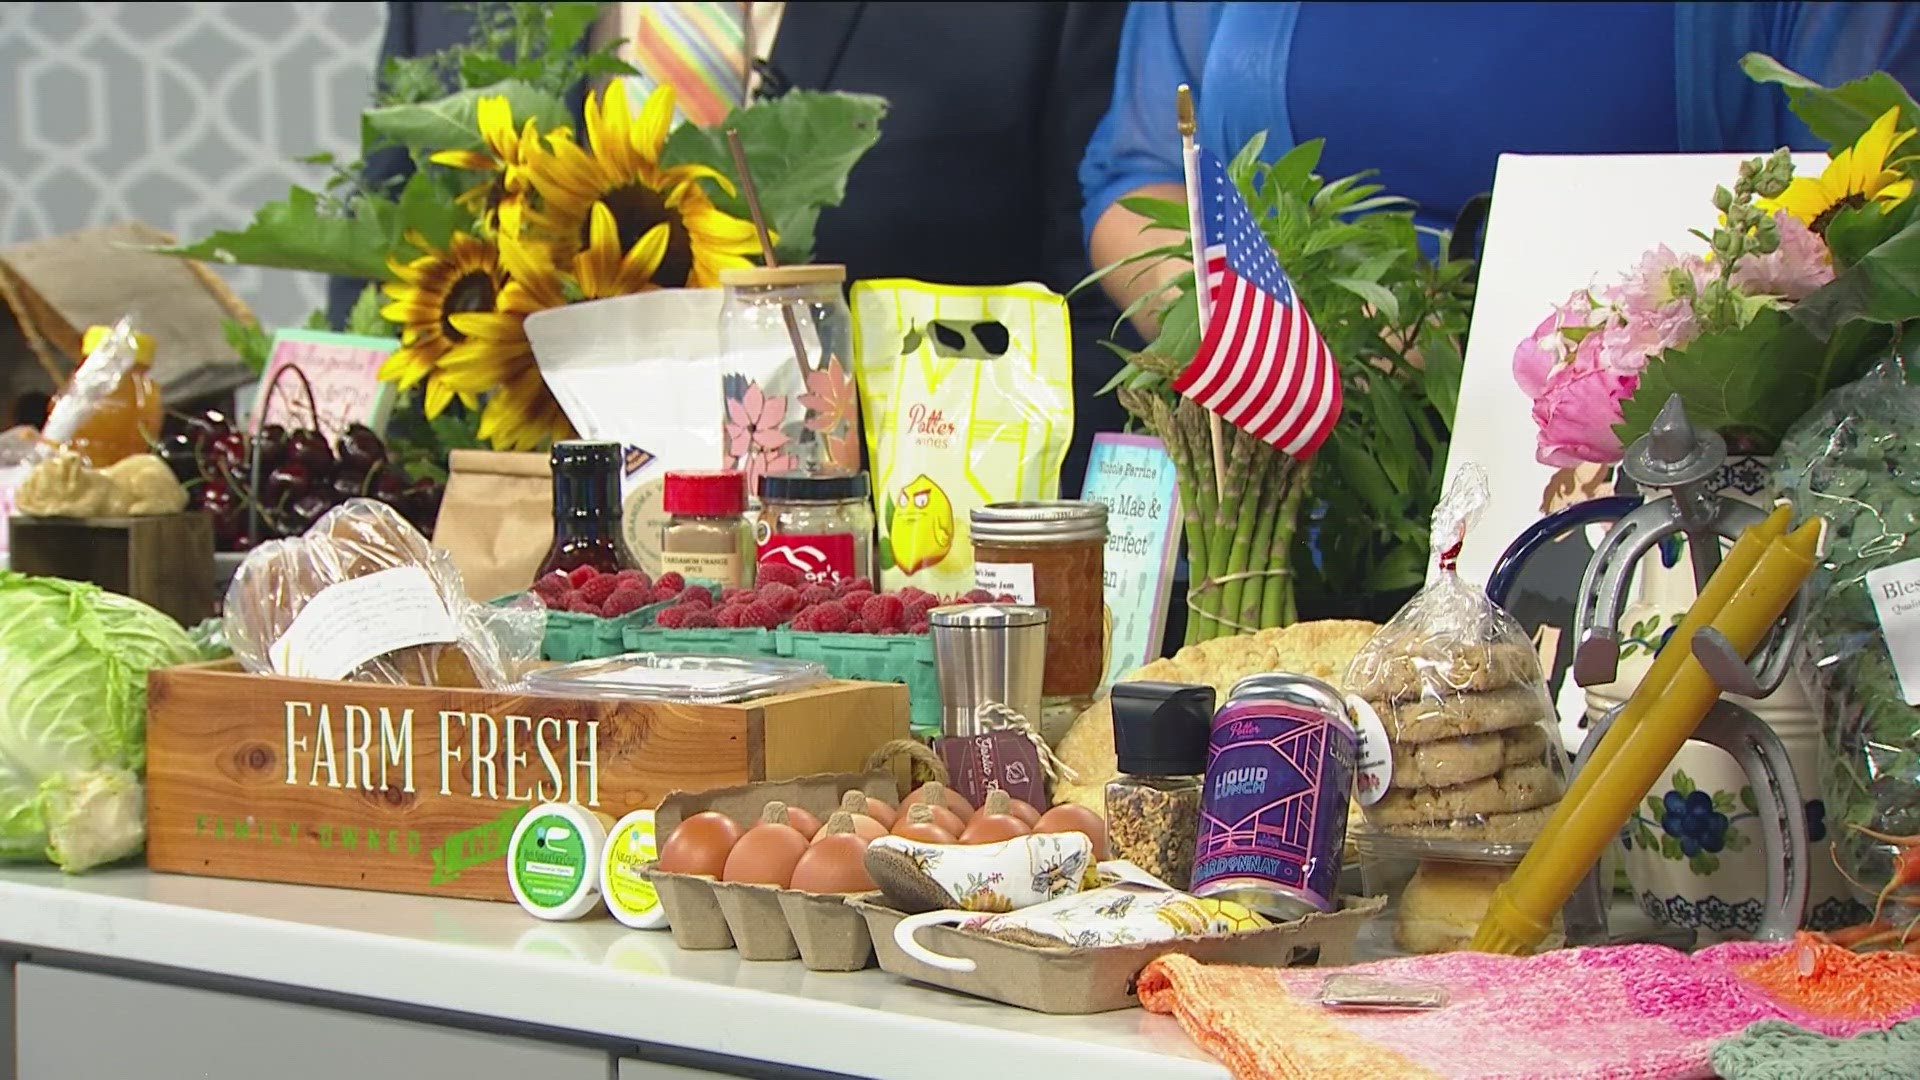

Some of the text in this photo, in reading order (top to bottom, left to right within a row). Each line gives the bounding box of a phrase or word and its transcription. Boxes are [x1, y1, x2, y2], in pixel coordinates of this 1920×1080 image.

[907, 403, 955, 436] Potter
[1117, 494, 1146, 518] Mae
[1147, 497, 1162, 520] &
[1109, 531, 1148, 556] erfect
[284, 700, 601, 806] FARM FRESH
[1215, 767, 1268, 789] LIQUID
[196, 813, 421, 855] FAMILY OWNED
